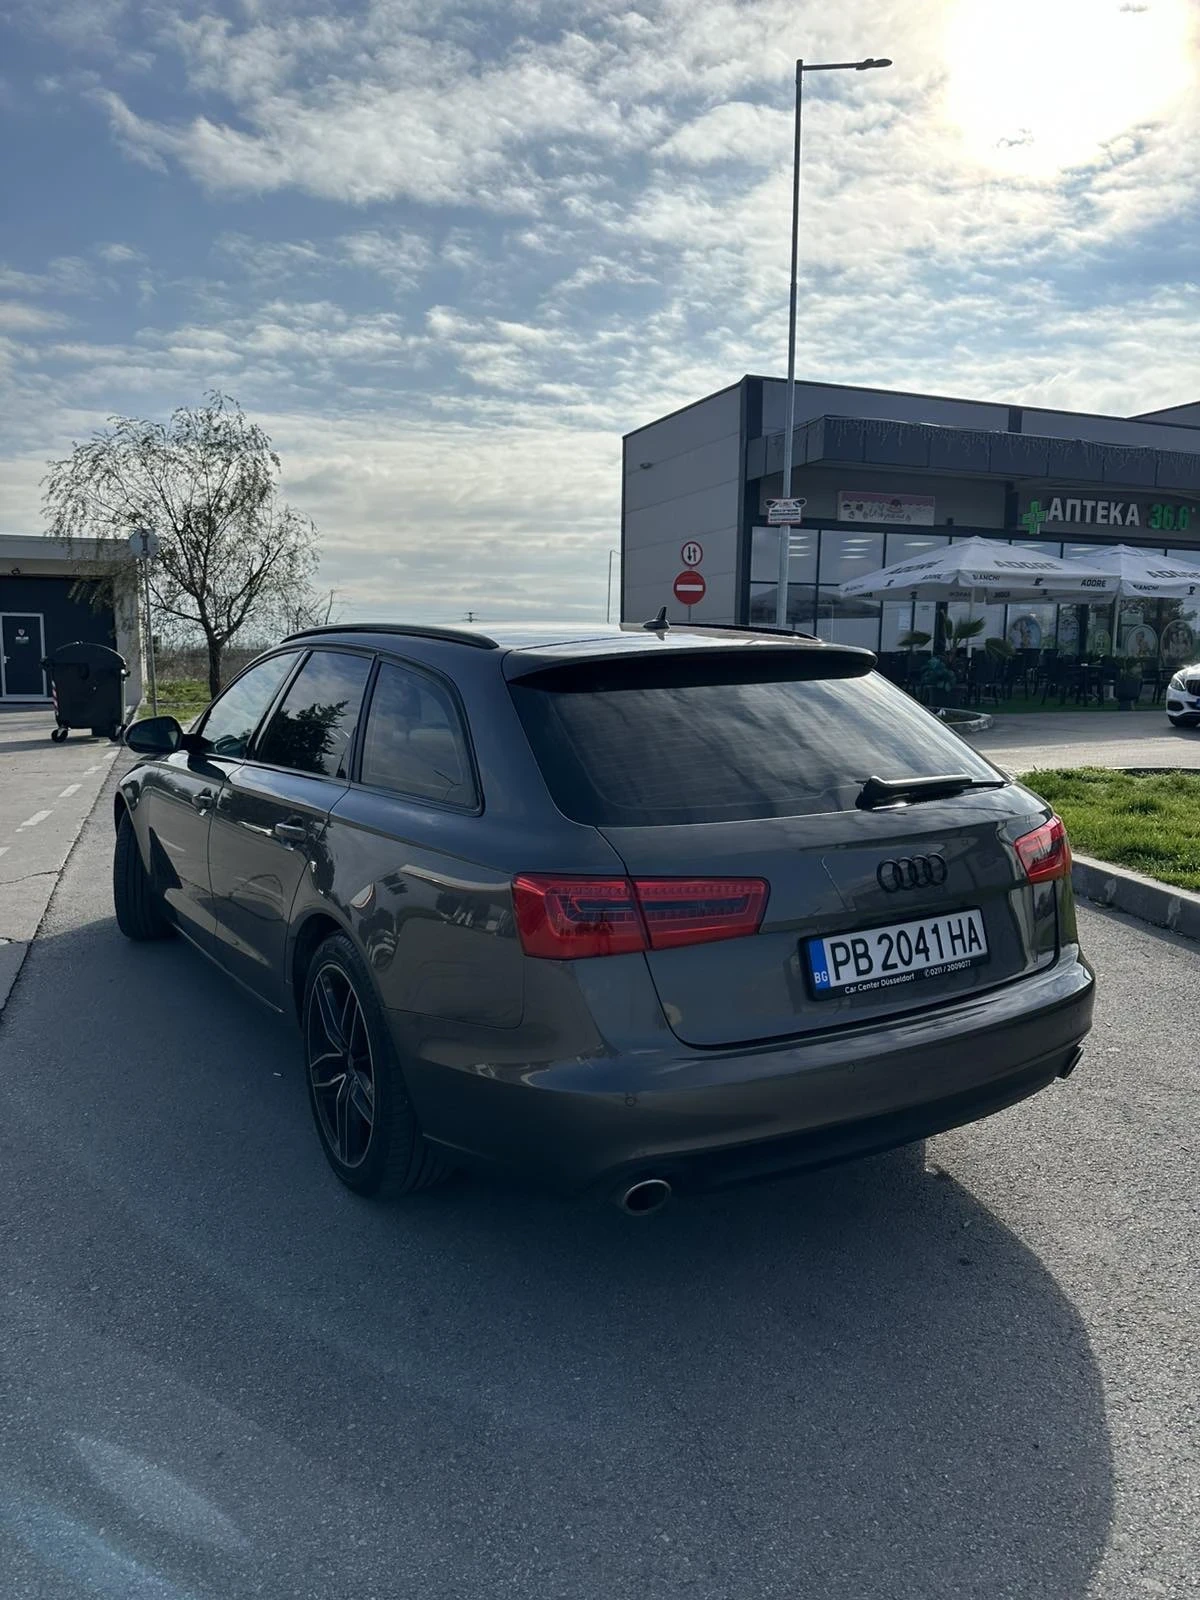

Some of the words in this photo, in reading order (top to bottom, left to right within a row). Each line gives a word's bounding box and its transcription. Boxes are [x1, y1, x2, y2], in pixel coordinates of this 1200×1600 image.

[1048, 497, 1140, 526] АПТЕКА
[1080, 579, 1107, 588] ADORE
[830, 938, 874, 981] PB
[877, 923, 944, 972] 2041
[947, 916, 983, 956] HA
[813, 971, 828, 984] BG
[844, 986, 857, 994] Car
[858, 982, 880, 992] Center
[881, 973, 915, 988] Düsseldorf
